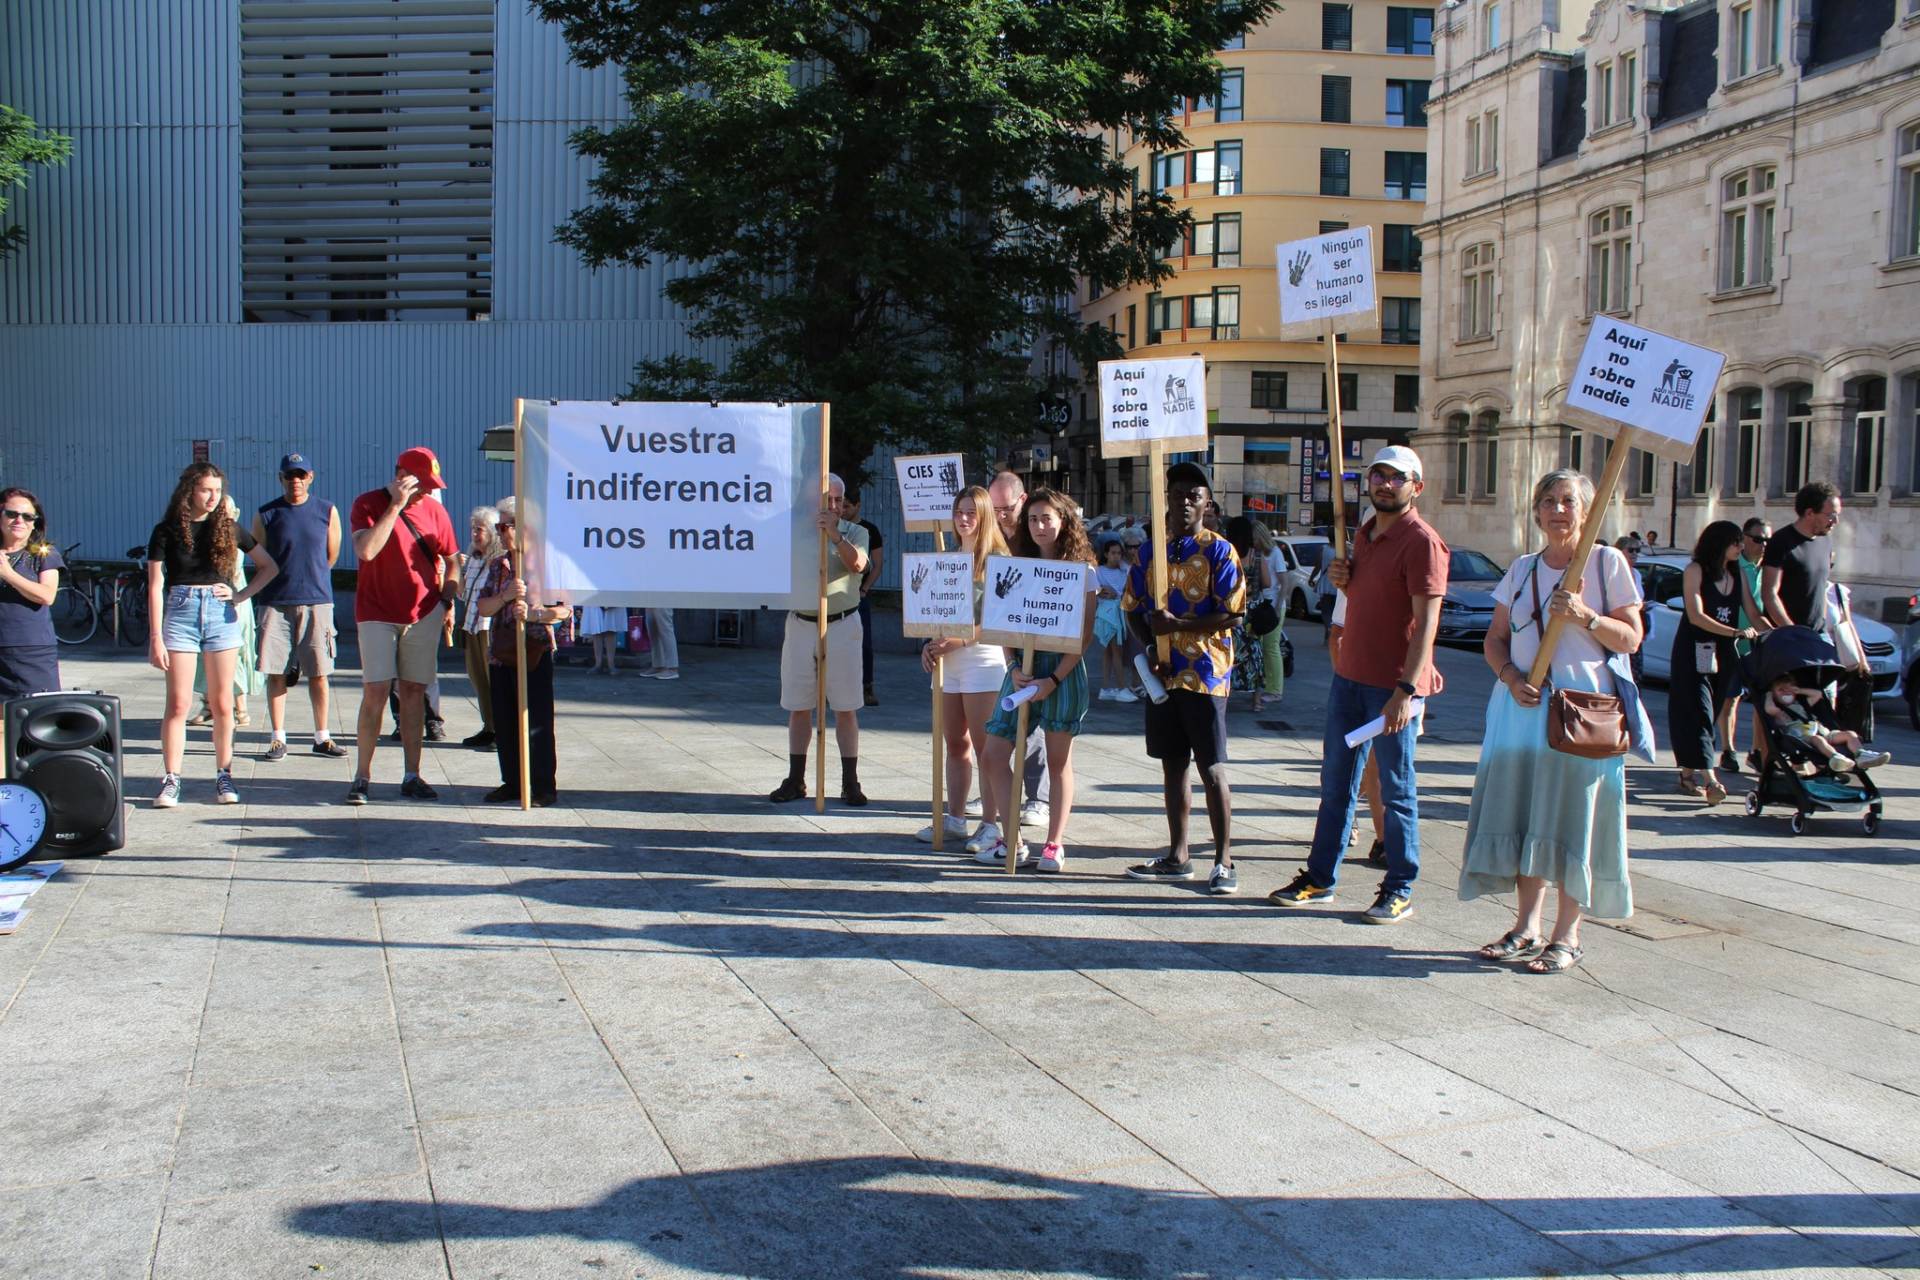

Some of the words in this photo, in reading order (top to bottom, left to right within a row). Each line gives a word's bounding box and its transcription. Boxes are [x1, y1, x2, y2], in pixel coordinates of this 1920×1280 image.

[1322, 236, 1363, 254] Ningún
[1334, 258, 1352, 270] ser
[1316, 274, 1364, 290] humano
[1304, 301, 1318, 310] es
[1321, 291, 1352, 308] ilegal
[1604, 328, 1648, 352] Aquí
[1608, 352, 1630, 366] no
[1114, 368, 1145, 382] Aquí
[1590, 366, 1636, 389] sobra
[1122, 387, 1138, 396] no
[1582, 384, 1630, 407] nadie
[1112, 400, 1148, 413] sobra
[1162, 400, 1196, 416] NADIE
[1651, 392, 1694, 410] NADIE
[1112, 416, 1150, 429] nadie
[600, 424, 736, 454] Vuestra
[908, 465, 934, 478] CIES
[566, 472, 773, 503] indiferencia
[583, 526, 646, 549] nos
[669, 524, 755, 551] mata
[936, 560, 968, 573] Ningún
[1033, 566, 1078, 582] Ningún
[943, 578, 958, 586] ser
[930, 592, 966, 600] humano
[1044, 586, 1064, 596] ser
[921, 606, 930, 615] es
[932, 604, 956, 617] ilegal
[1022, 598, 1073, 612] humano
[1008, 613, 1022, 624] es
[1025, 612, 1058, 628] ilegal
[19, 793, 24, 802] 1
[30, 803, 37, 814] 2
[34, 818, 40, 829] 3
[26, 834, 33, 843] 4
[13, 846, 20, 856] 5
